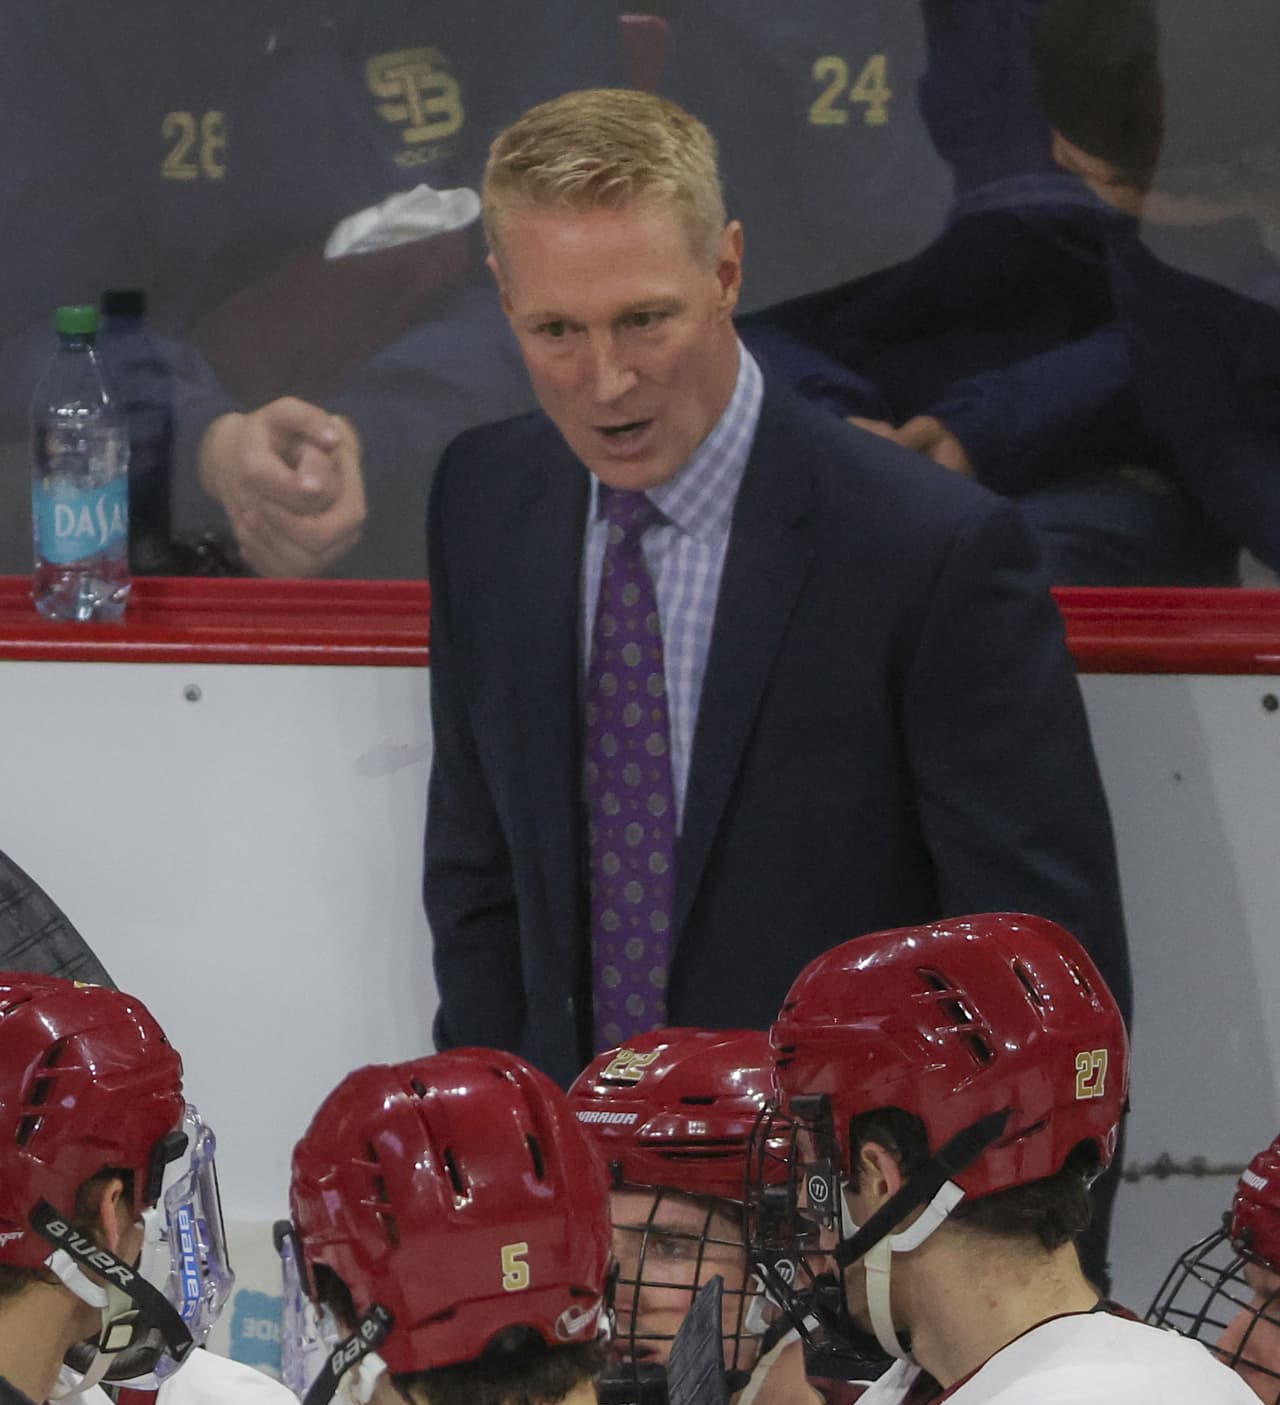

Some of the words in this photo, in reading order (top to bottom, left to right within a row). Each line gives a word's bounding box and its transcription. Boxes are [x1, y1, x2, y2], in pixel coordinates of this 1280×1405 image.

[806, 54, 892, 127] 24
[1074, 1048, 1109, 1101] 27
[500, 1241, 530, 1292] 5
